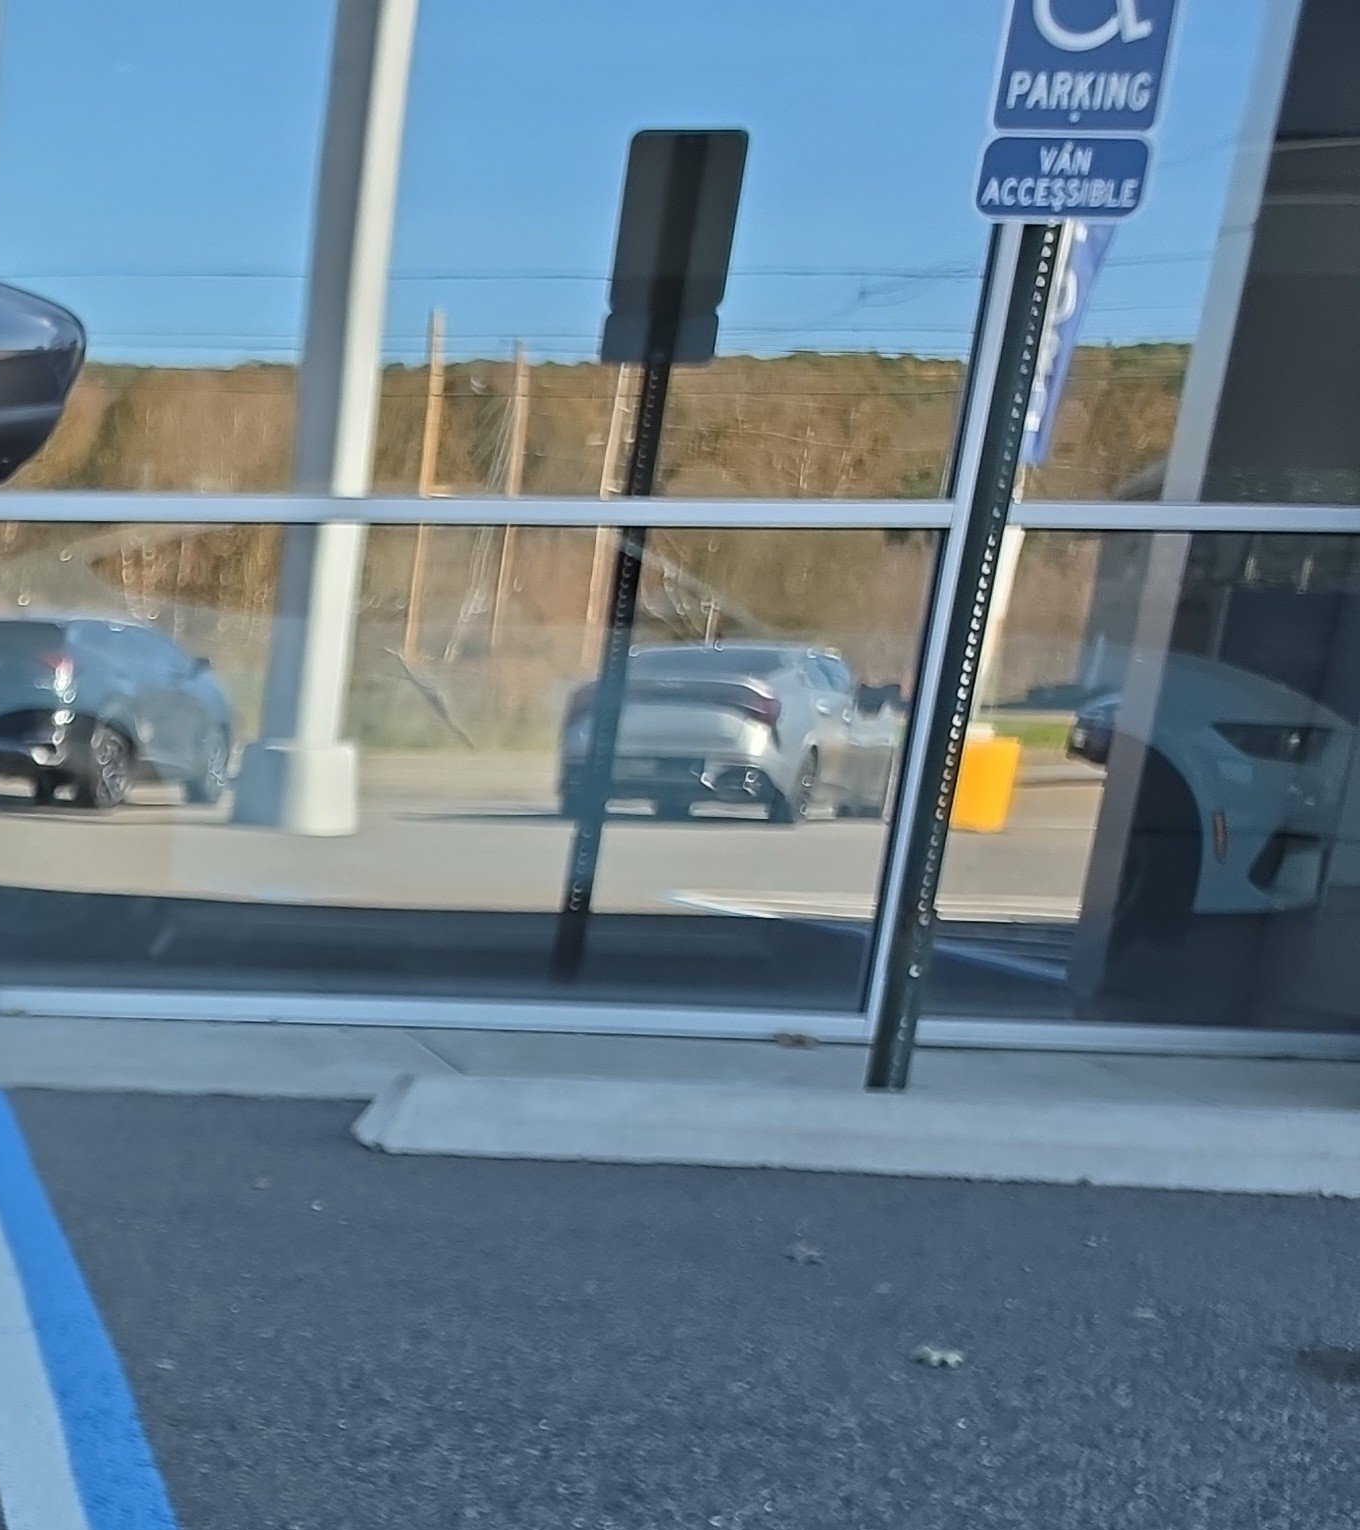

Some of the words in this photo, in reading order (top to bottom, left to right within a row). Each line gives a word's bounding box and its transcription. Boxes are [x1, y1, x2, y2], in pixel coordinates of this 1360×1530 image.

[1005, 70, 1153, 112] PARKING
[1039, 145, 1094, 176] VAN
[980, 176, 1141, 208] ACCESSIBLE
